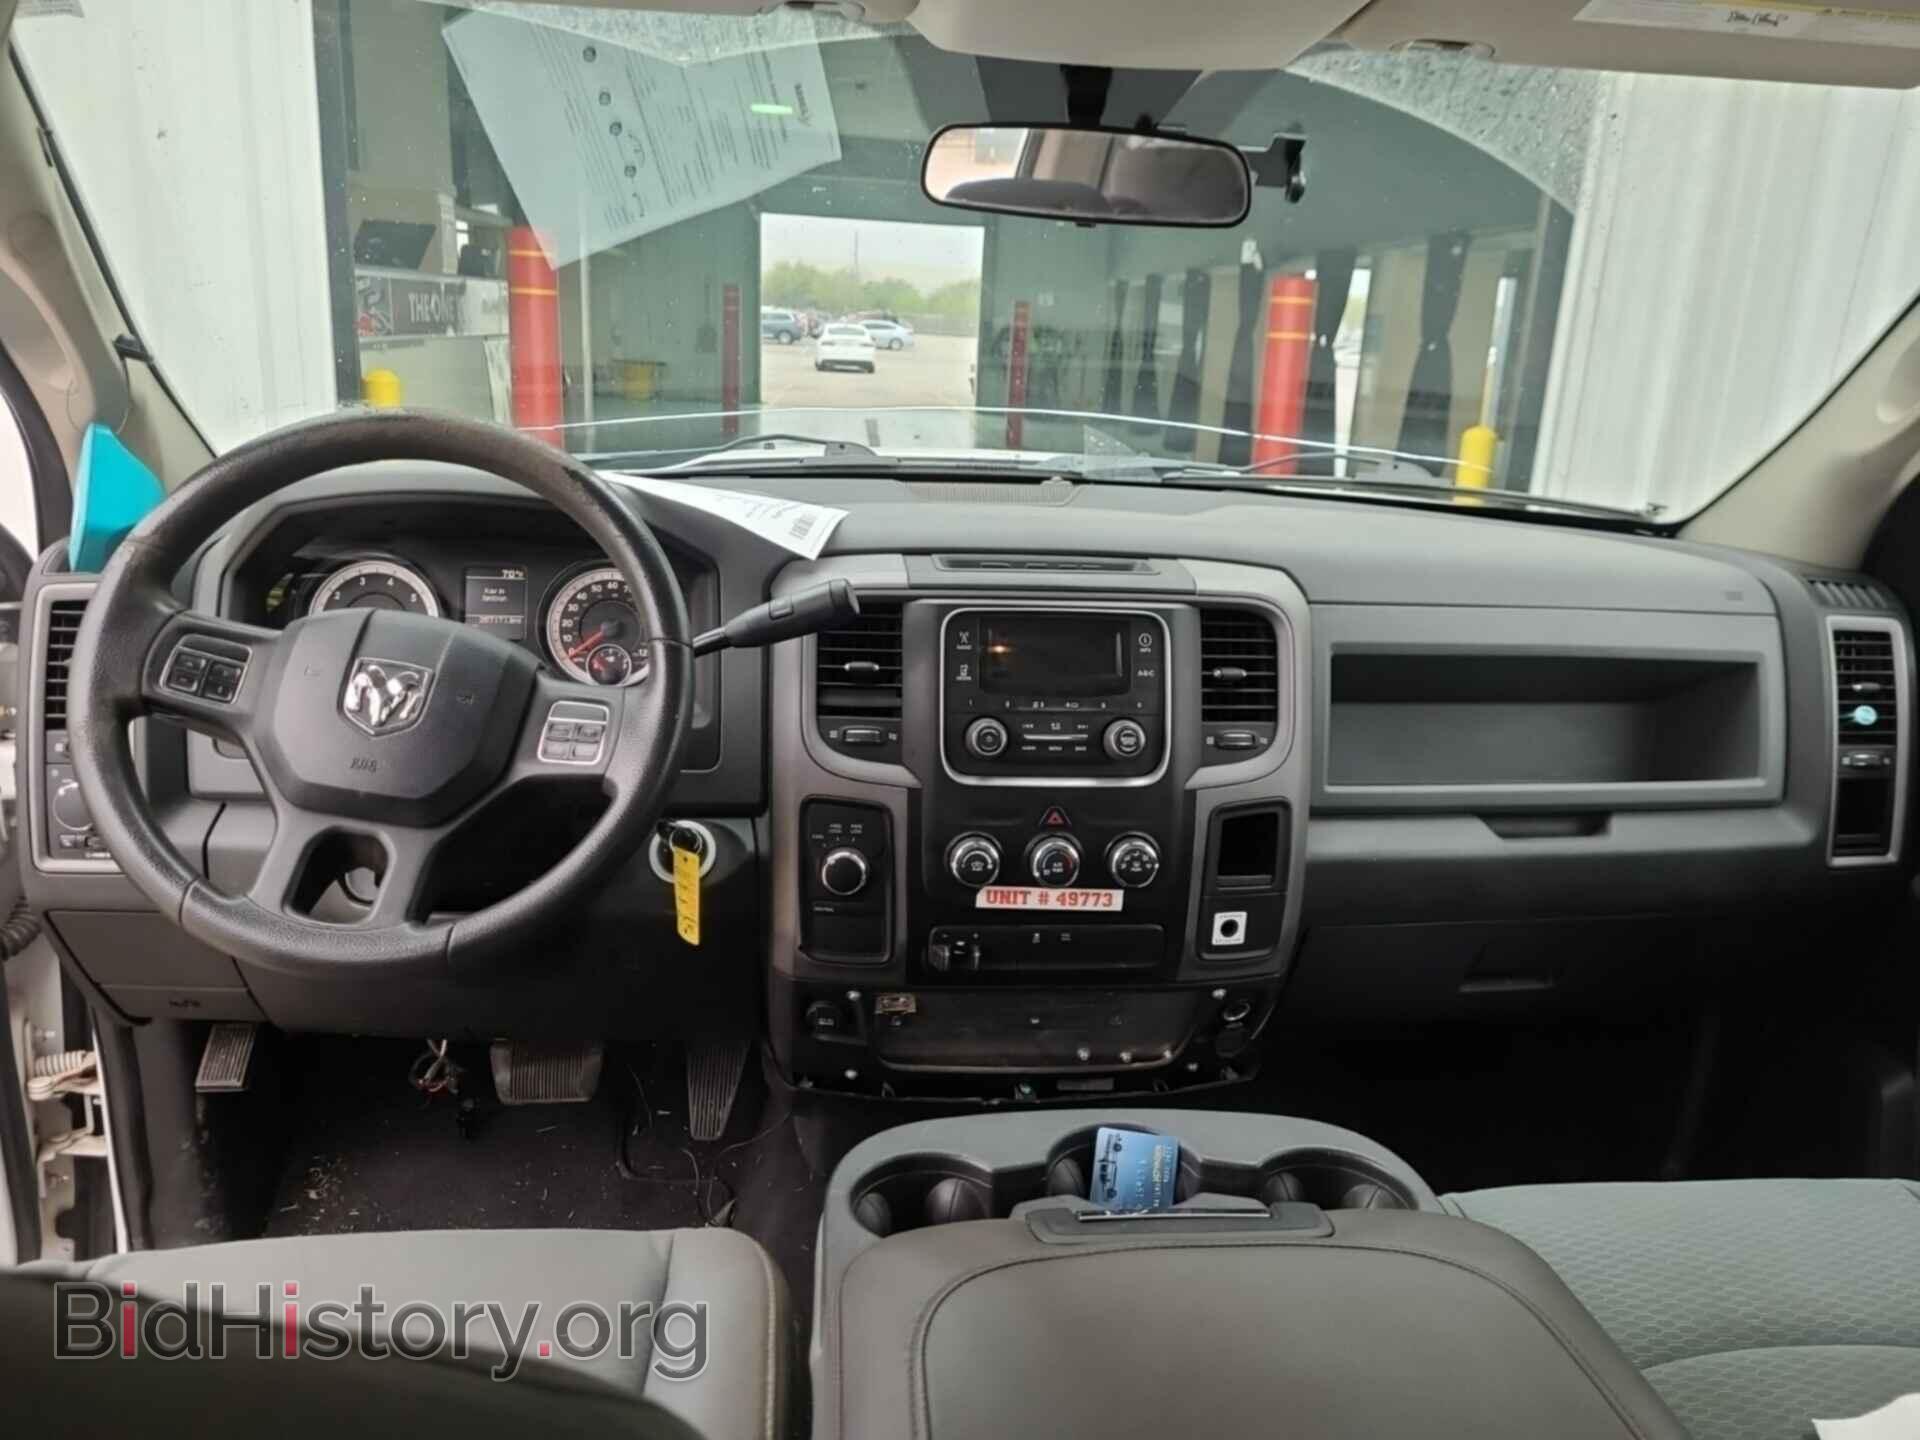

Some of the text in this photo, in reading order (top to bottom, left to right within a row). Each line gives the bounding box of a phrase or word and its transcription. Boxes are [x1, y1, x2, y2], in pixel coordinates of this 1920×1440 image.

[386, 577, 395, 587] 4
[985, 889, 1114, 908] UNIT # 49773
